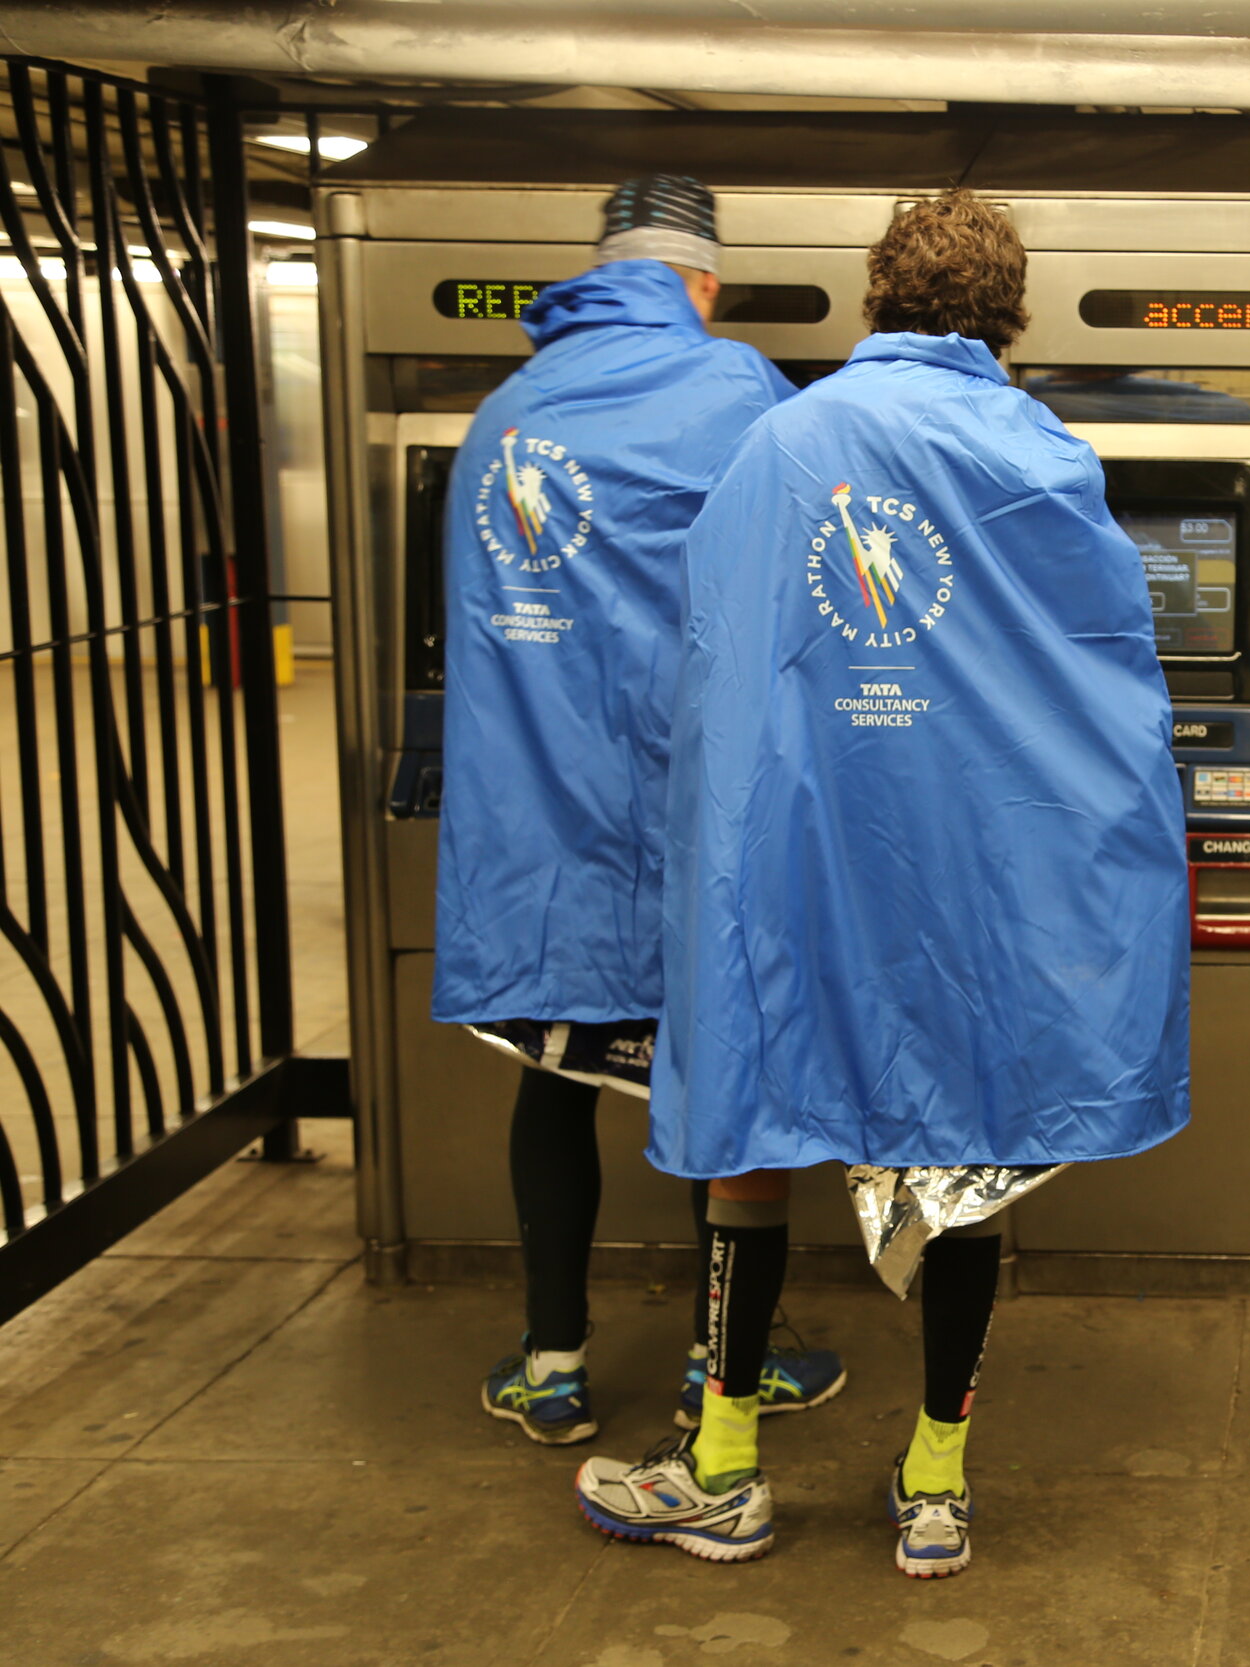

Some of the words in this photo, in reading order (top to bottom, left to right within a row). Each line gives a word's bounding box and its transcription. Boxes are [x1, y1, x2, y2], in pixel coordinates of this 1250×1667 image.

[525, 438, 567, 461] TCS
[563, 459, 594, 502] NEW
[475, 459, 516, 565] MARATHON
[866, 496, 916, 522] TCS
[560, 509, 593, 559] YORK
[917, 519, 953, 566] NEW
[519, 555, 561, 573] CITY
[807, 520, 858, 641] MARATHON
[513, 602, 550, 615] TATA
[919, 574, 954, 631] YORK
[490, 614, 574, 630] CONSULTANCY
[504, 628, 560, 643] SERVICES
[865, 627, 917, 648] CITY
[860, 683, 902, 696] TATA
[834, 698, 930, 712] CONSULTANCY
[851, 714, 913, 727] SERVICES
[1173, 724, 1208, 738] CARD
